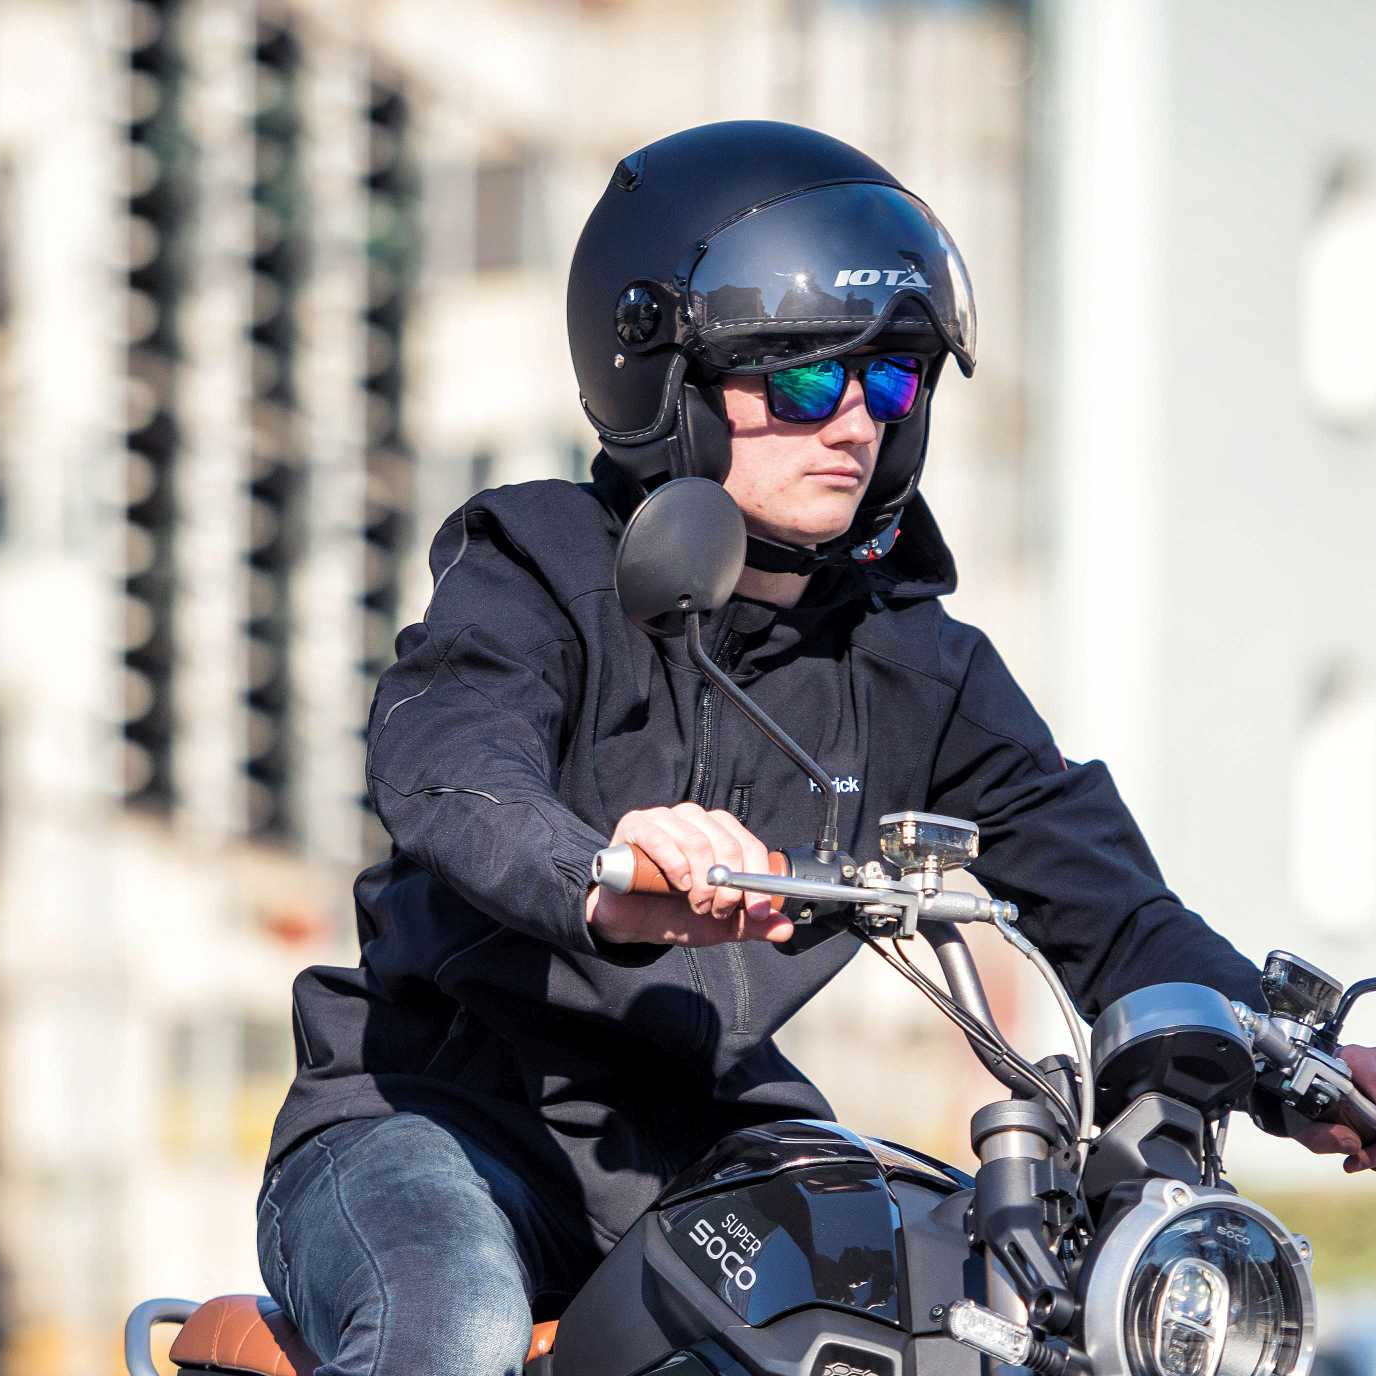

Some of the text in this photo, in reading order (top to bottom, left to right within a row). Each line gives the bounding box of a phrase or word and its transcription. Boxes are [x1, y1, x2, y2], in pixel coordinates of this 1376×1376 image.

[834, 269, 933, 288] IOTA
[688, 1218, 757, 1291] SOCO
[721, 1213, 762, 1257] SUPER
